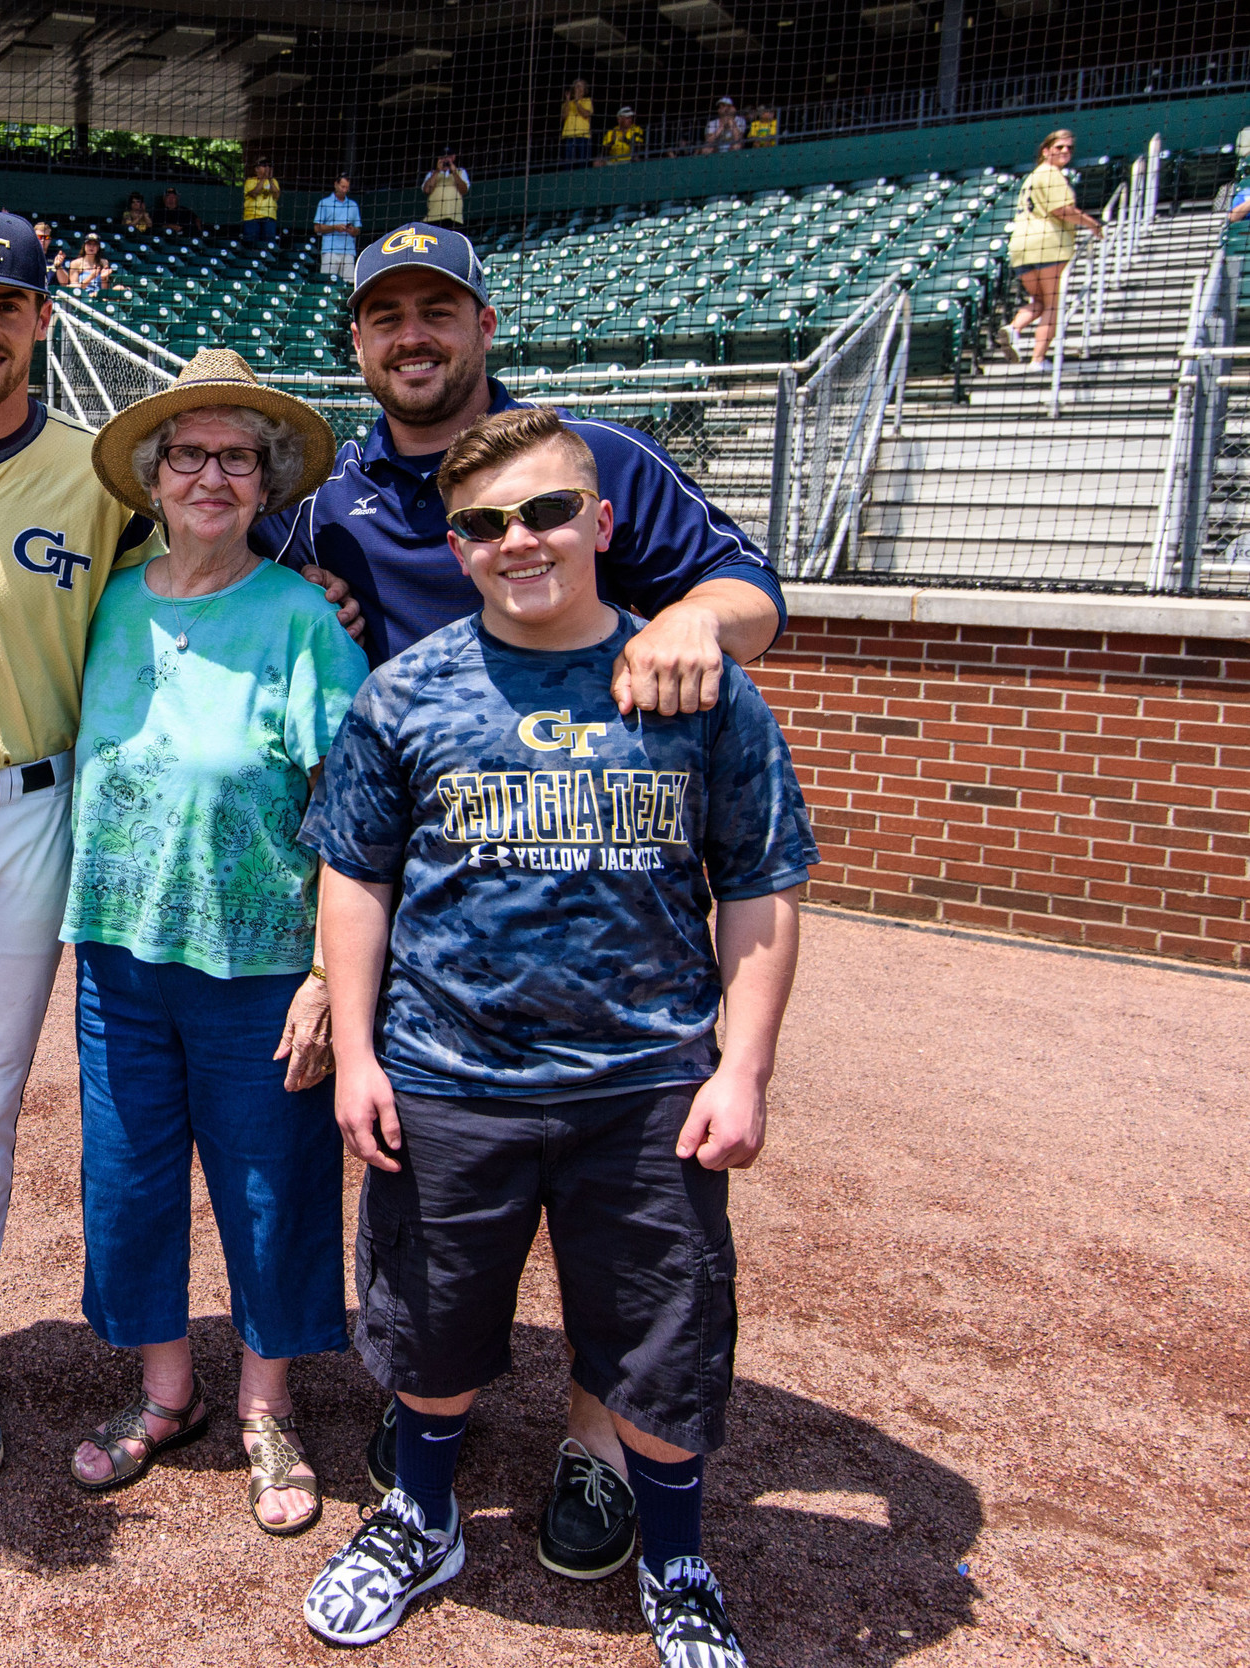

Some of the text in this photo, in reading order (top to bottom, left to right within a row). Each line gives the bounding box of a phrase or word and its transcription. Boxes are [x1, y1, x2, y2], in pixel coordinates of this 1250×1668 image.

[381, 227, 438, 254] GT
[12, 526, 92, 591] GT
[517, 709, 607, 758] GT
[437, 769, 604, 844] GEORGIA
[513, 846, 590, 872] YELLOW
[682, 1565, 708, 1581] PUMA
